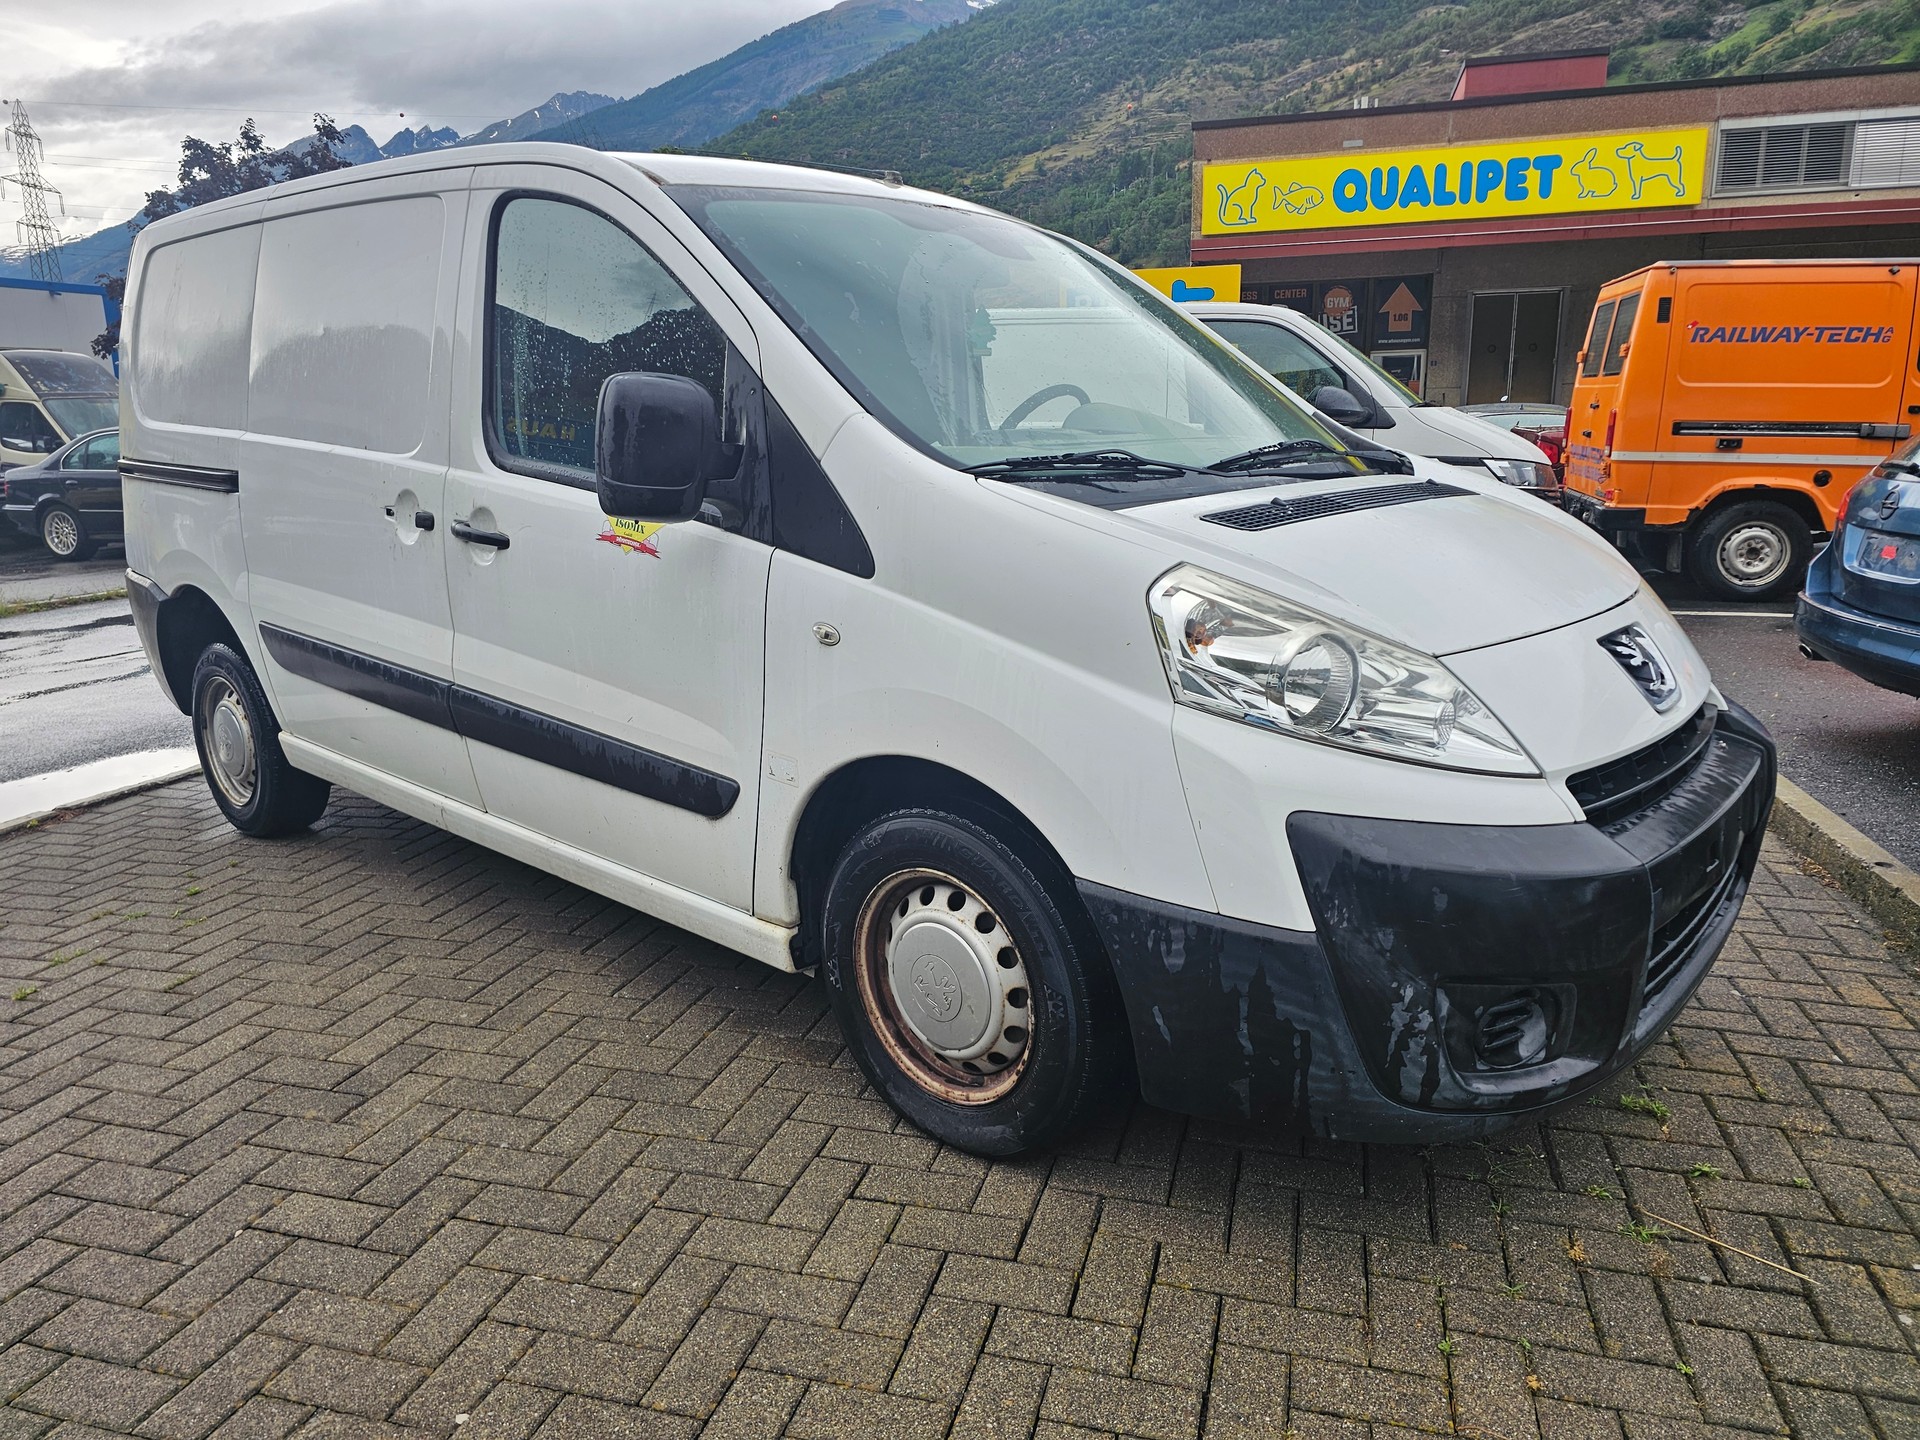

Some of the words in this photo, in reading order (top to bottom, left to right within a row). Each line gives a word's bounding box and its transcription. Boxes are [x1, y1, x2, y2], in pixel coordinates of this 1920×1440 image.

[1333, 154, 1563, 213] QUALIPET
[1242, 291, 1258, 300] ESS
[1274, 288, 1307, 299] CENTER
[1327, 296, 1349, 308] GYM
[1690, 327, 1885, 343] RAILWAY-TECH
[615, 518, 646, 534] ISOMIX
